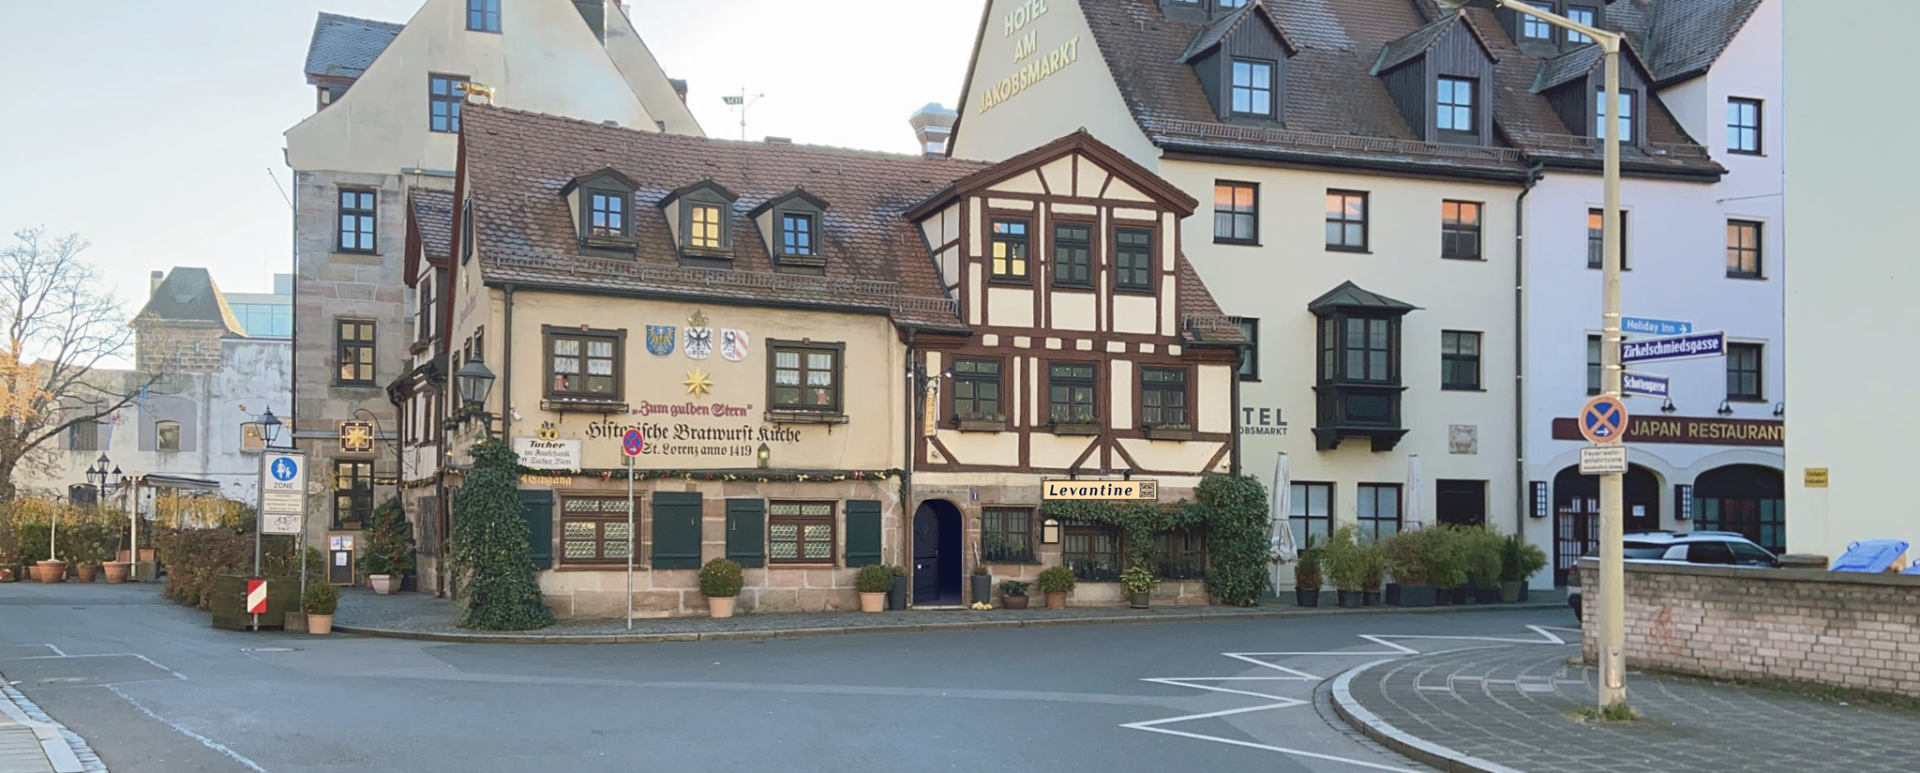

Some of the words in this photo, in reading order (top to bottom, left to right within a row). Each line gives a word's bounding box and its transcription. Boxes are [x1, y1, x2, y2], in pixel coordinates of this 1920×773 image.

[1004, 0, 1048, 37] HOTEL
[1013, 29, 1036, 63] AM
[977, 36, 1079, 114] JAKOBSMARKT
[1627, 320, 1658, 333] Holiday
[1662, 324, 1675, 332] Inn
[1623, 338, 1718, 358] Zirkelschmiedsgasse
[585, 421, 669, 441] Histosche
[673, 423, 753, 442] Bratwurst
[1630, 421, 1681, 437] JAPAN
[1689, 423, 1784, 441] RESTAURANT
[530, 440, 565, 448] Tucher
[662, 442, 698, 457] Lorenz
[700, 444, 727, 456] anno
[729, 445, 752, 457] 1419
[1049, 483, 1133, 496] Levantine
